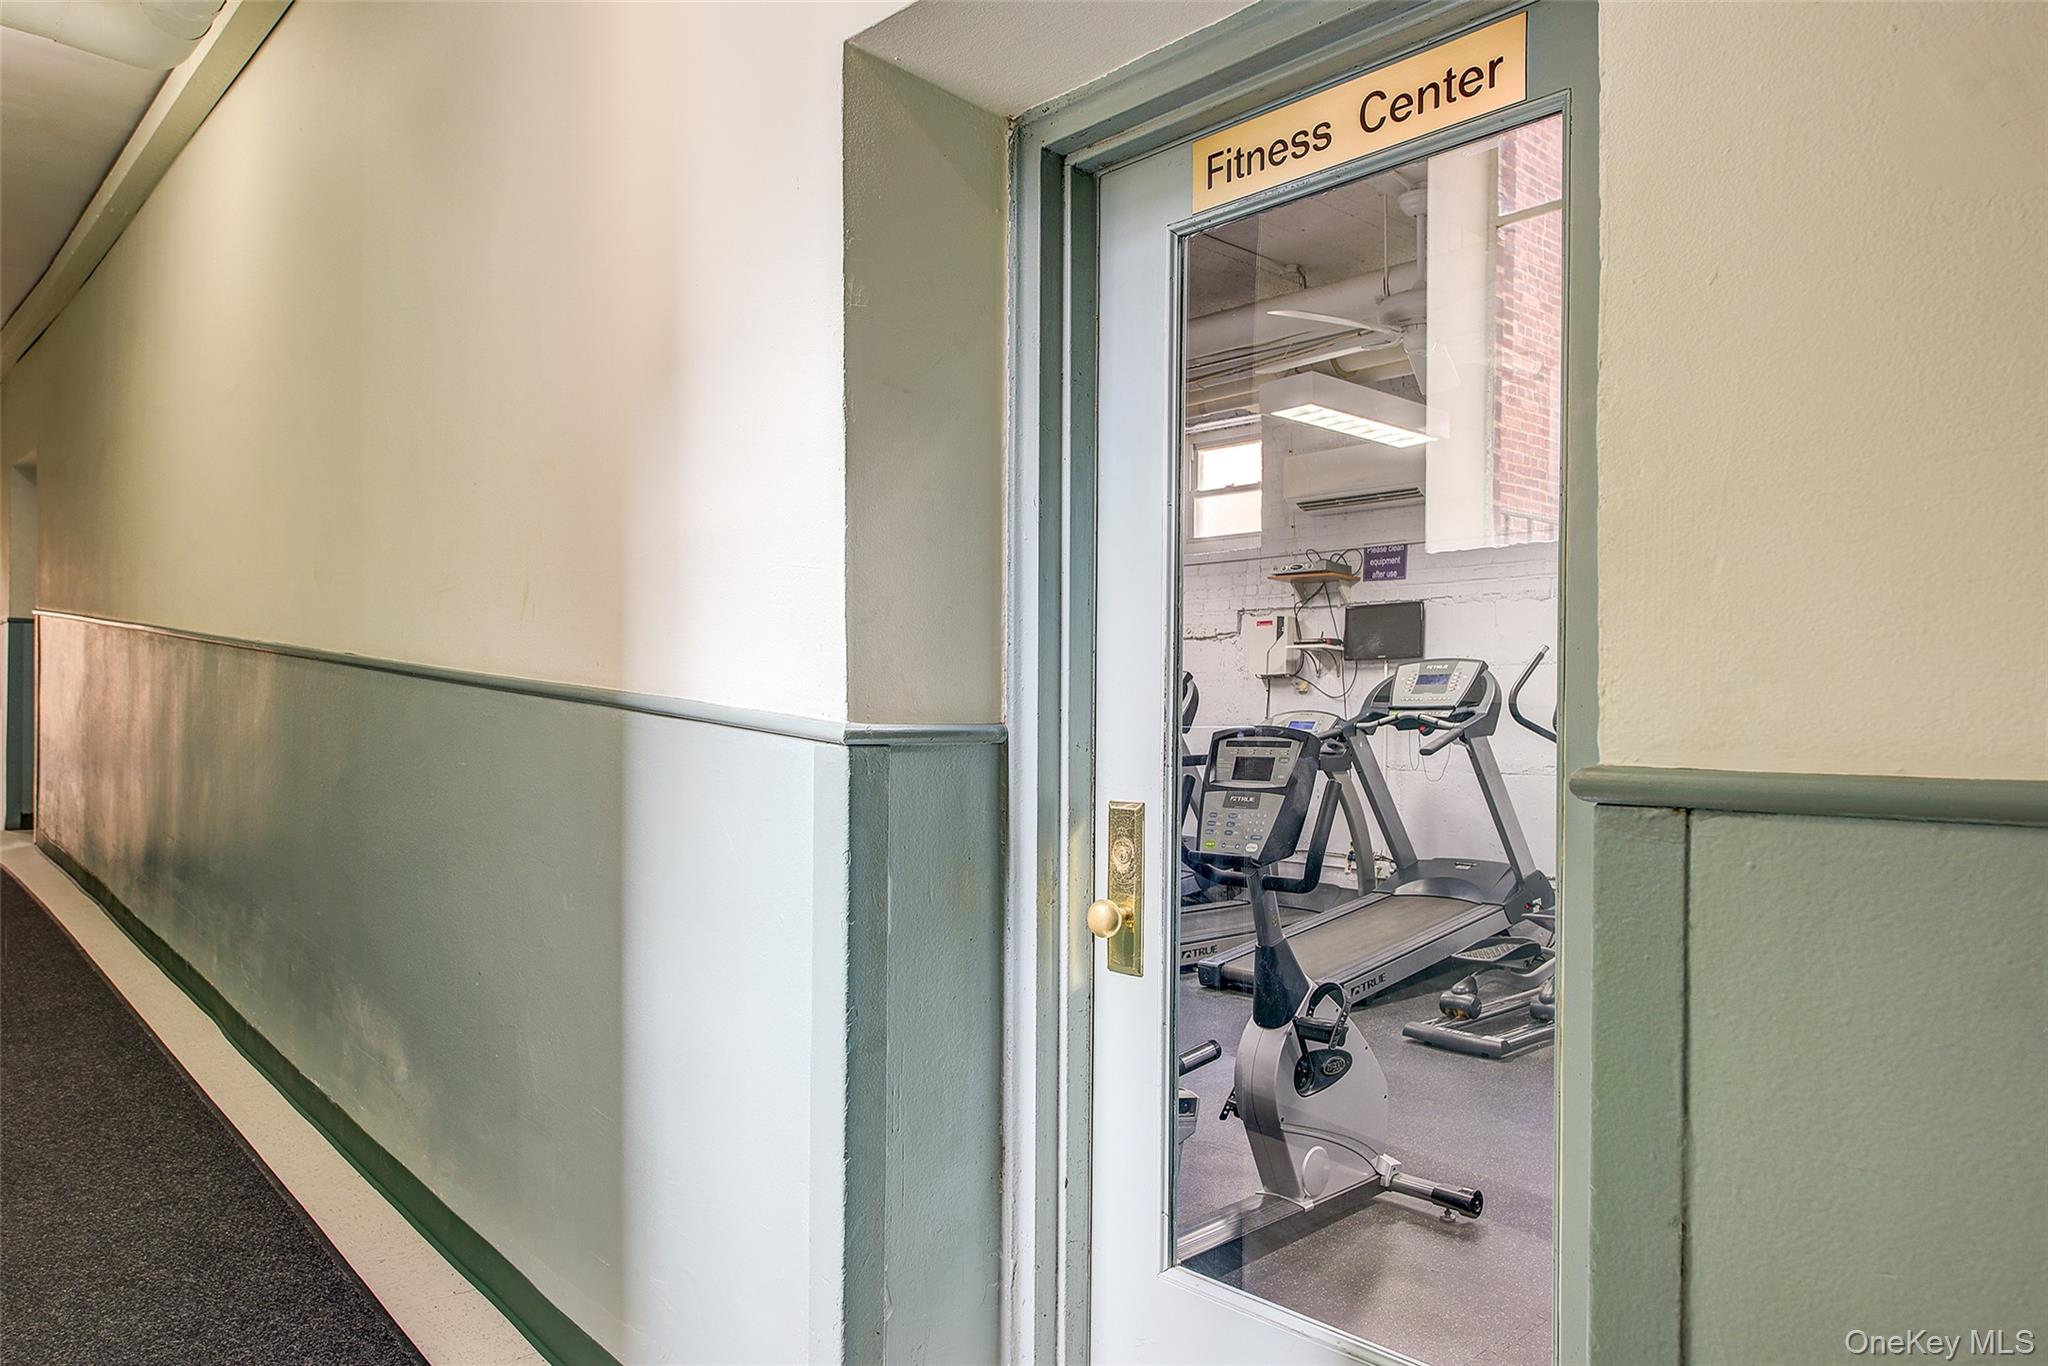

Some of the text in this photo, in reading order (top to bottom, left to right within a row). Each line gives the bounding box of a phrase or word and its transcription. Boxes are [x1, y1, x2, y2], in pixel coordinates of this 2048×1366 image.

[1207, 55, 1504, 190] Fitness Center
[1369, 556, 1401, 567] equipment
[1372, 570, 1398, 579] after use
[1192, 944, 1218, 958] TRUE
[1361, 972, 1386, 992] TRUE
